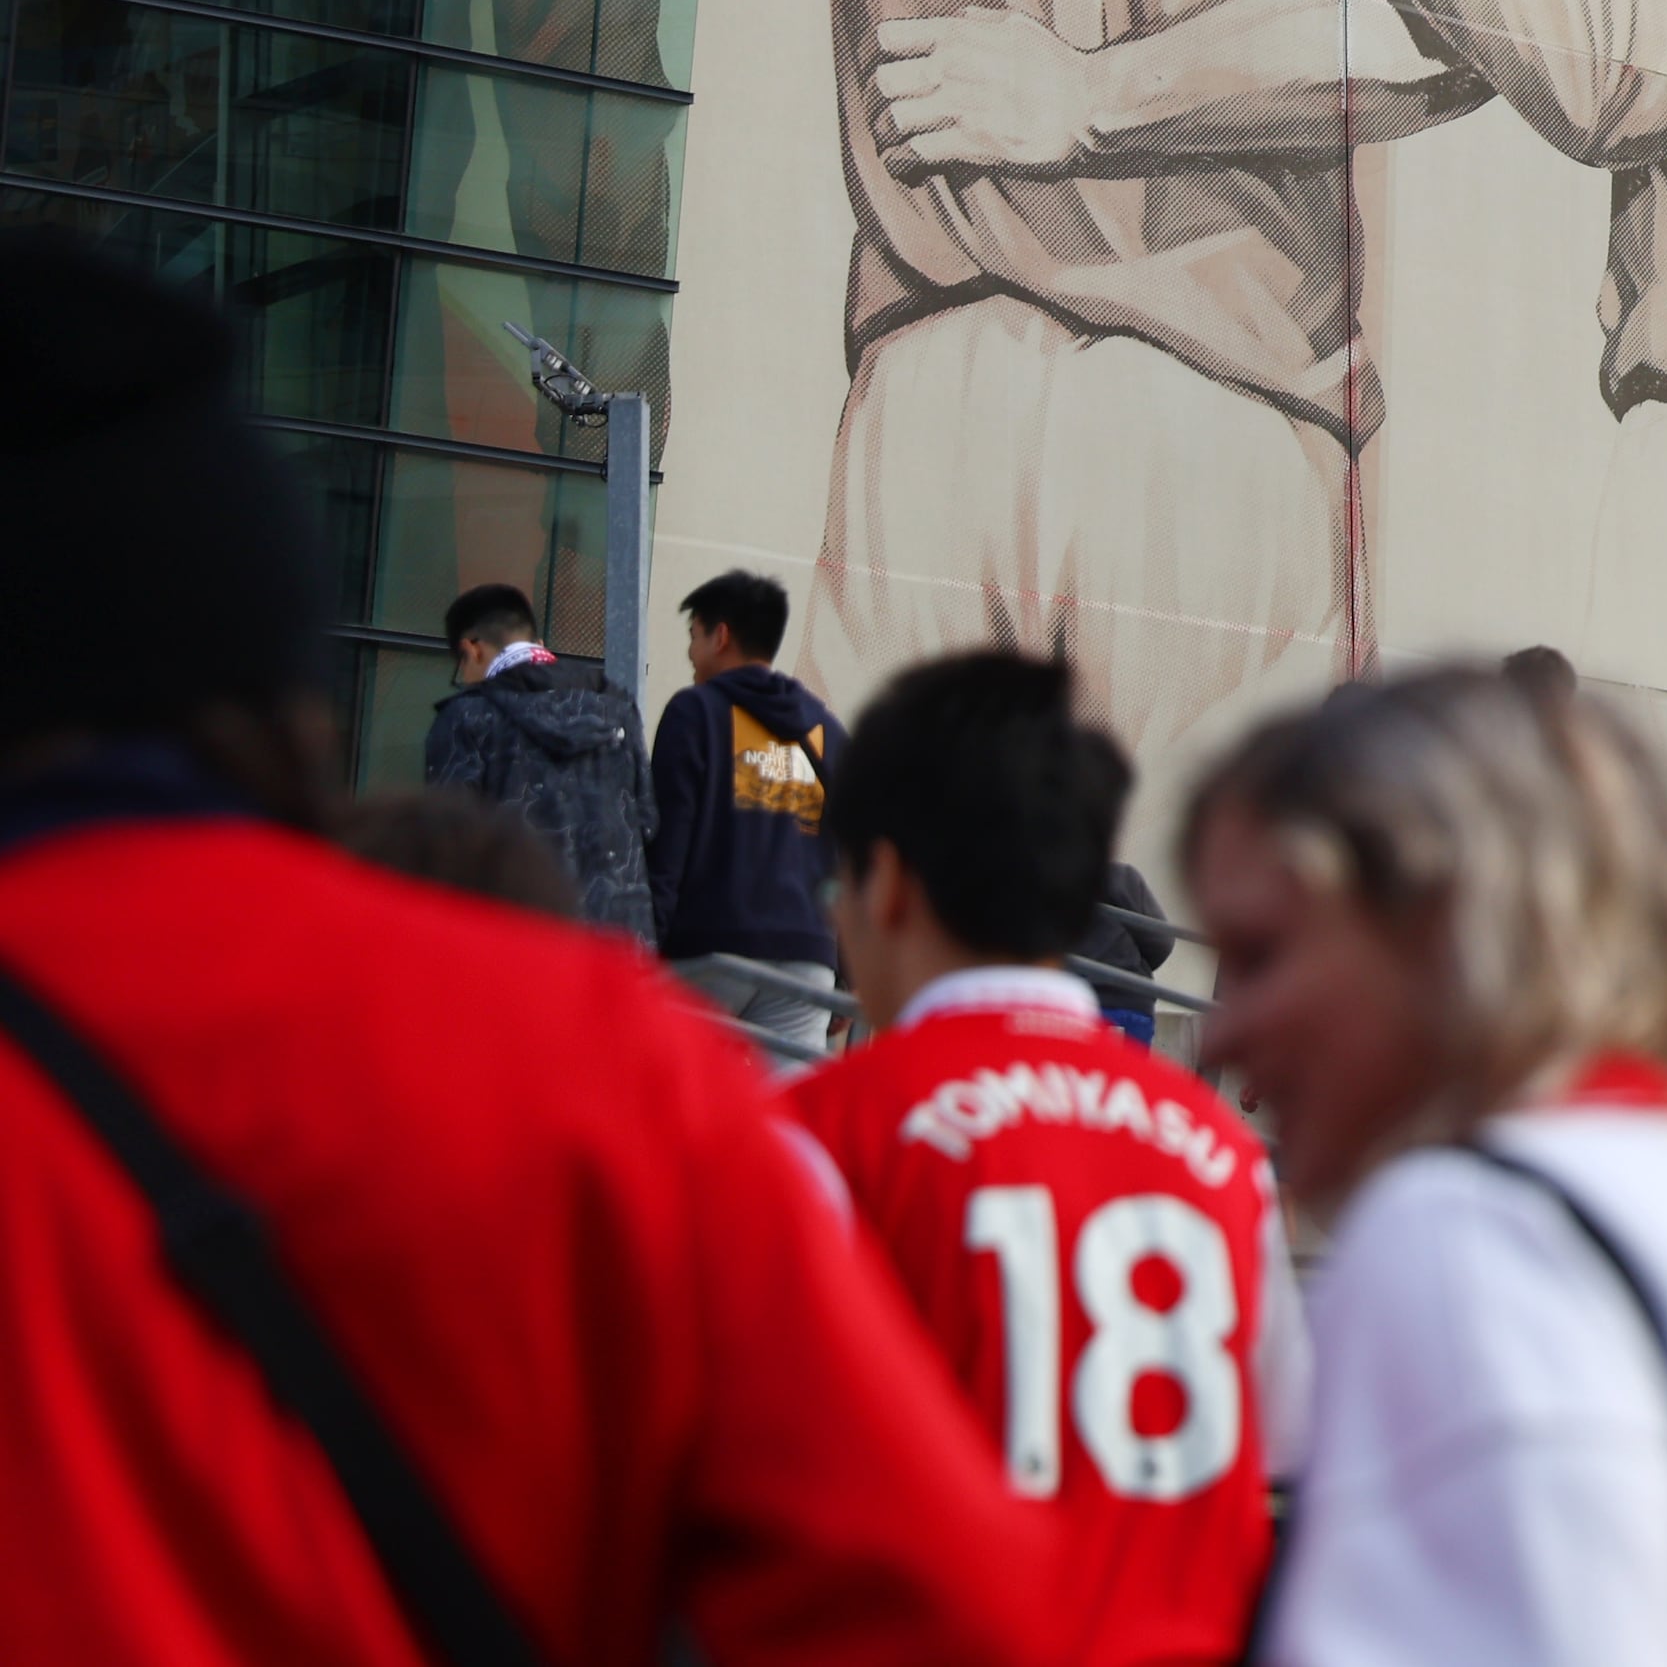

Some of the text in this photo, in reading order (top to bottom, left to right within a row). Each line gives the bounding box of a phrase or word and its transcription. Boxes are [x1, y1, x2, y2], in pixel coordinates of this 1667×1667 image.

[759, 762, 793, 782] FACE
[768, 740, 792, 758] THE
[900, 1062, 1238, 1188] TOMIYASU
[965, 1183, 1241, 1505] 18
